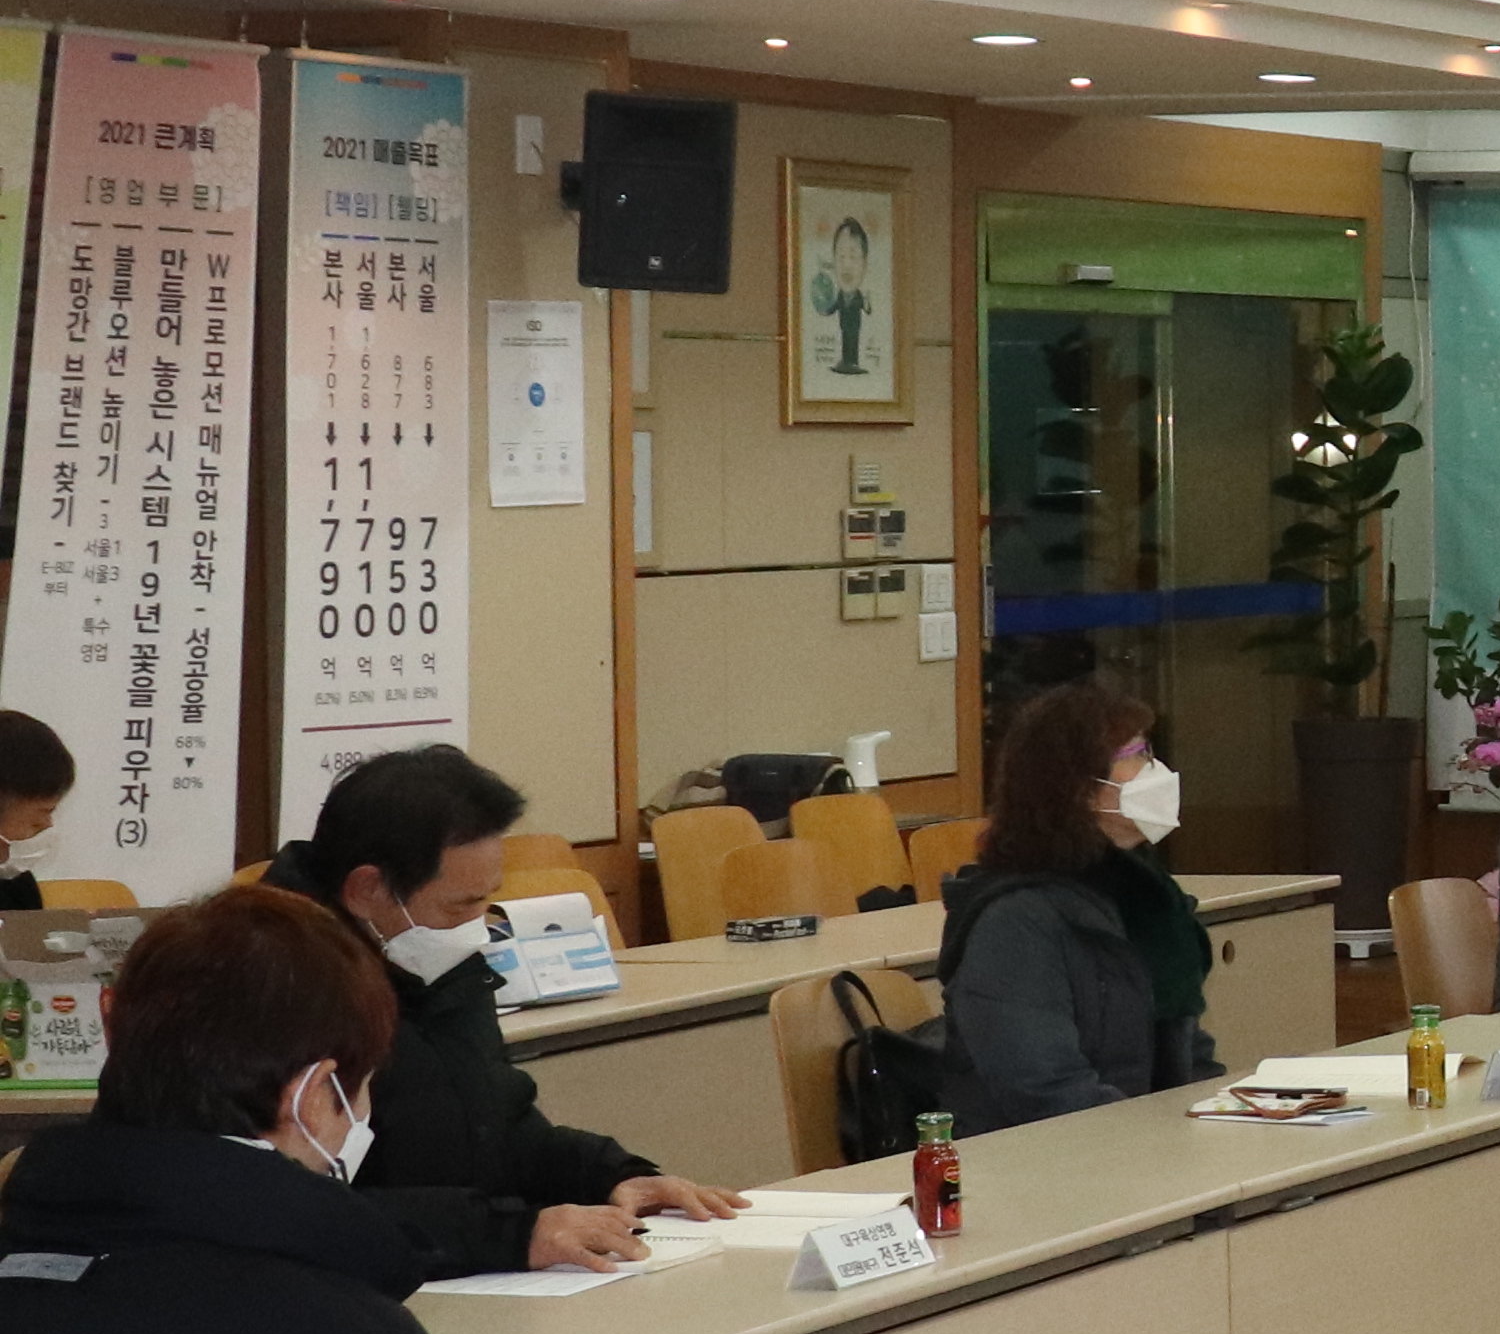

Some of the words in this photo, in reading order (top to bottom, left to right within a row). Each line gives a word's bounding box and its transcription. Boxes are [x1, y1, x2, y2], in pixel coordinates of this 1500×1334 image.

[99, 120, 145, 145] 2021
[323, 136, 367, 160] 2021
[66, 245, 94, 343] 도망간
[105, 245, 136, 377] 블루오션
[156, 248, 188, 346] 만들어
[56, 354, 85, 448] 브랜드
[149, 355, 181, 420] 놓은
[97, 388, 125, 485] 높이기
[50, 461, 78, 528] 찾기
[141, 430, 175, 528] 시스템
[118, 717, 153, 814] 피우자
[115, 818, 148, 849] (3)
[839, 1222, 897, 1247] 대구육상연맹
[877, 1238, 925, 1268] 전준석
